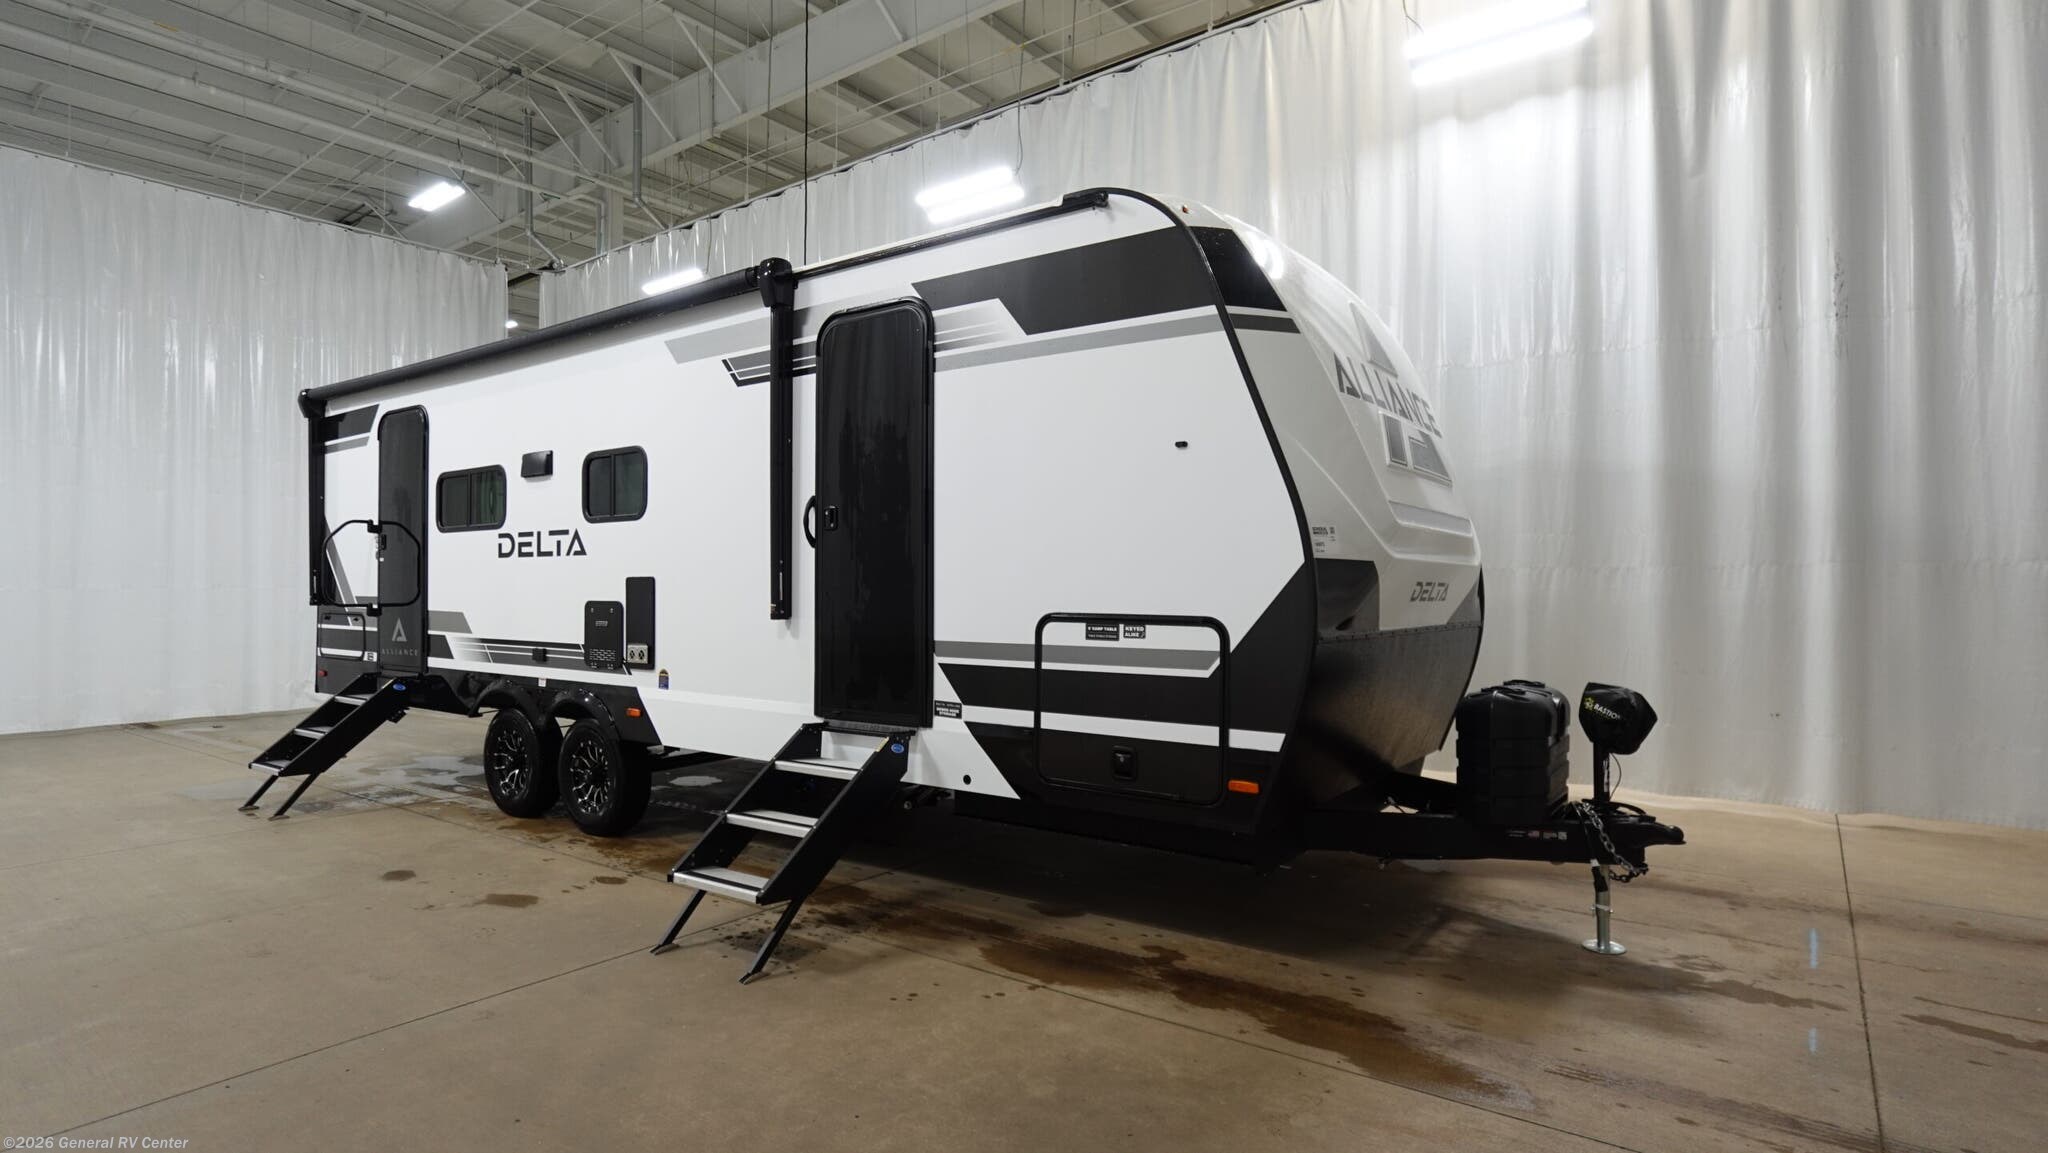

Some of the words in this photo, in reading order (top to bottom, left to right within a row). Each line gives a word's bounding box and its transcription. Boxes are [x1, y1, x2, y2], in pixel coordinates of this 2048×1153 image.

[1334, 352, 1442, 439] ALLIANCE
[498, 528, 587, 558] DELTA
[1410, 581, 1449, 602] DELTA
[381, 648, 418, 657] ALLIANCE
